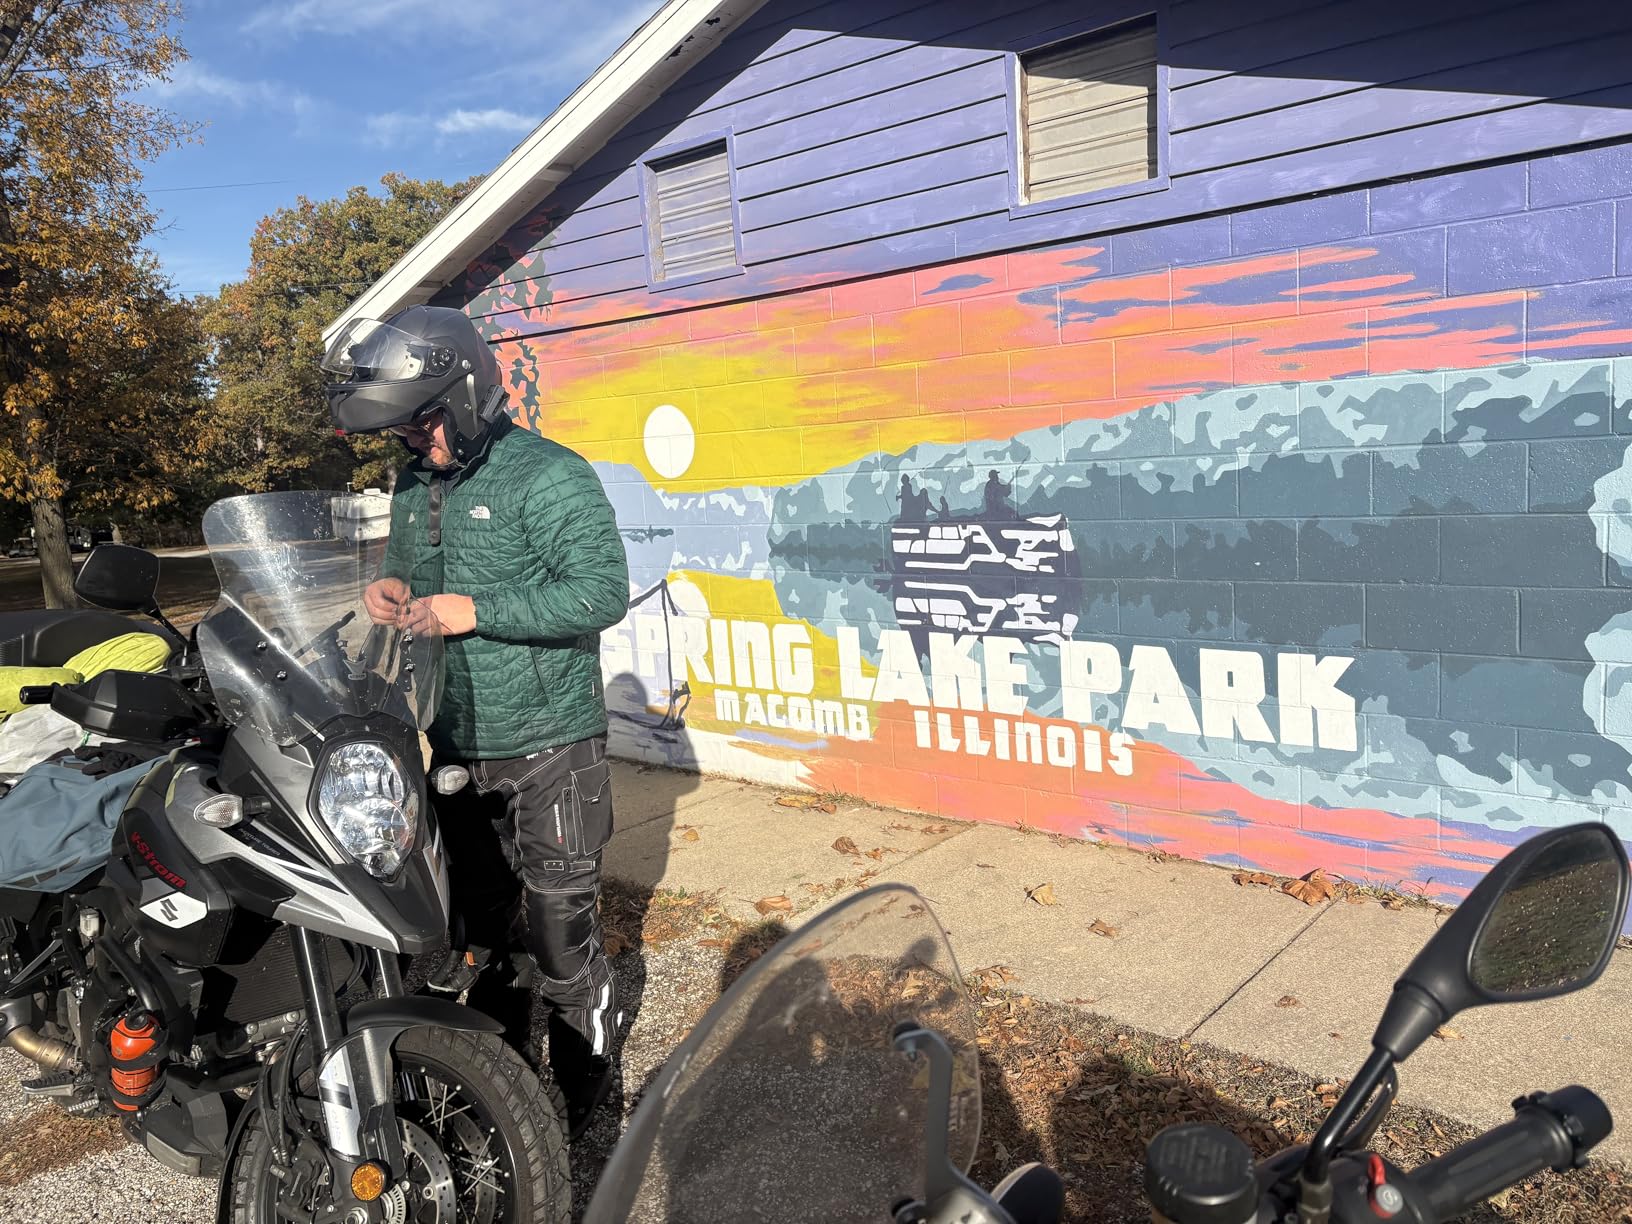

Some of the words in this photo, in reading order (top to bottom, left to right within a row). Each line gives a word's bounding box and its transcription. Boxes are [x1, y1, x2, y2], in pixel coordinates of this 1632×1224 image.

[600, 612, 815, 695] SPRING
[836, 626, 1030, 716] LAKE
[1059, 640, 1358, 752] PARK
[713, 688, 873, 741] MACOMB
[913, 709, 1136, 776] ILLINOIS
